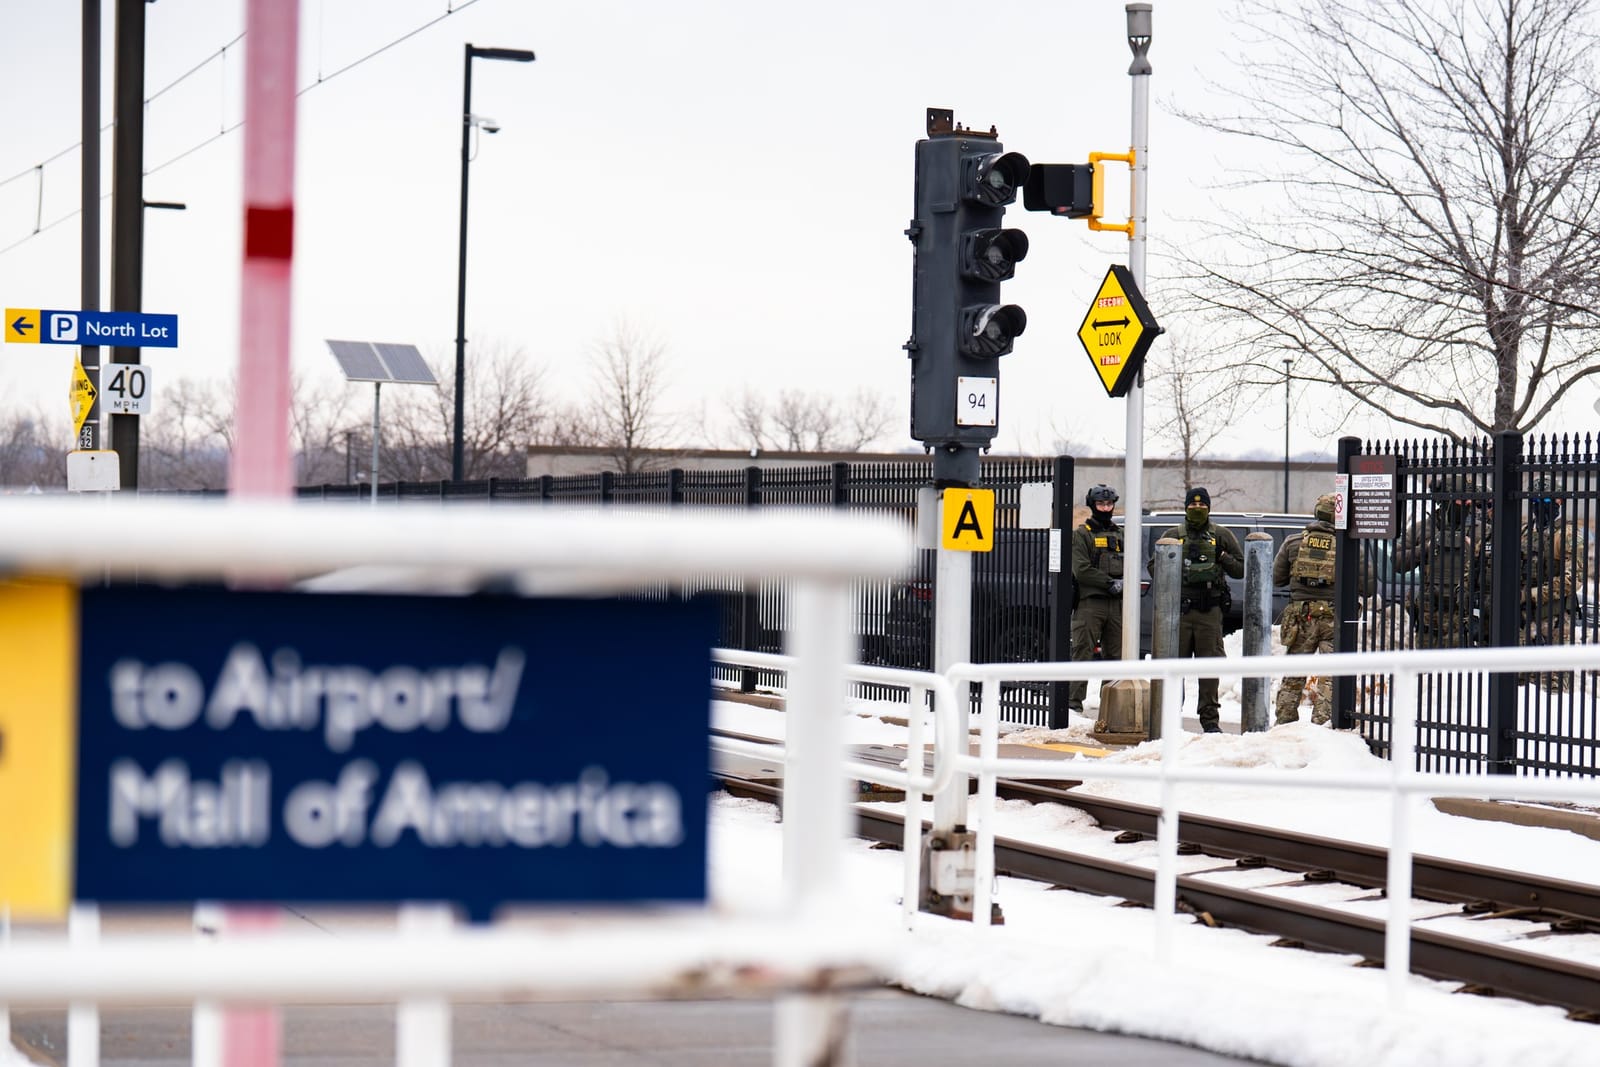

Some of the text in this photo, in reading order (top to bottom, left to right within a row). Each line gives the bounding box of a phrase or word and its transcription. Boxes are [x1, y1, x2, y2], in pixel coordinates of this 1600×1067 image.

[57, 317, 169, 338] P North Lot
[1099, 332, 1122, 346] LOOK
[108, 369, 146, 399] 40
[113, 401, 139, 409] MPH
[968, 393, 986, 409] 94
[952, 500, 984, 540] A
[1309, 537, 1331, 549] POLICE
[110, 658, 205, 730] to
[109, 757, 686, 848] Mall of America
